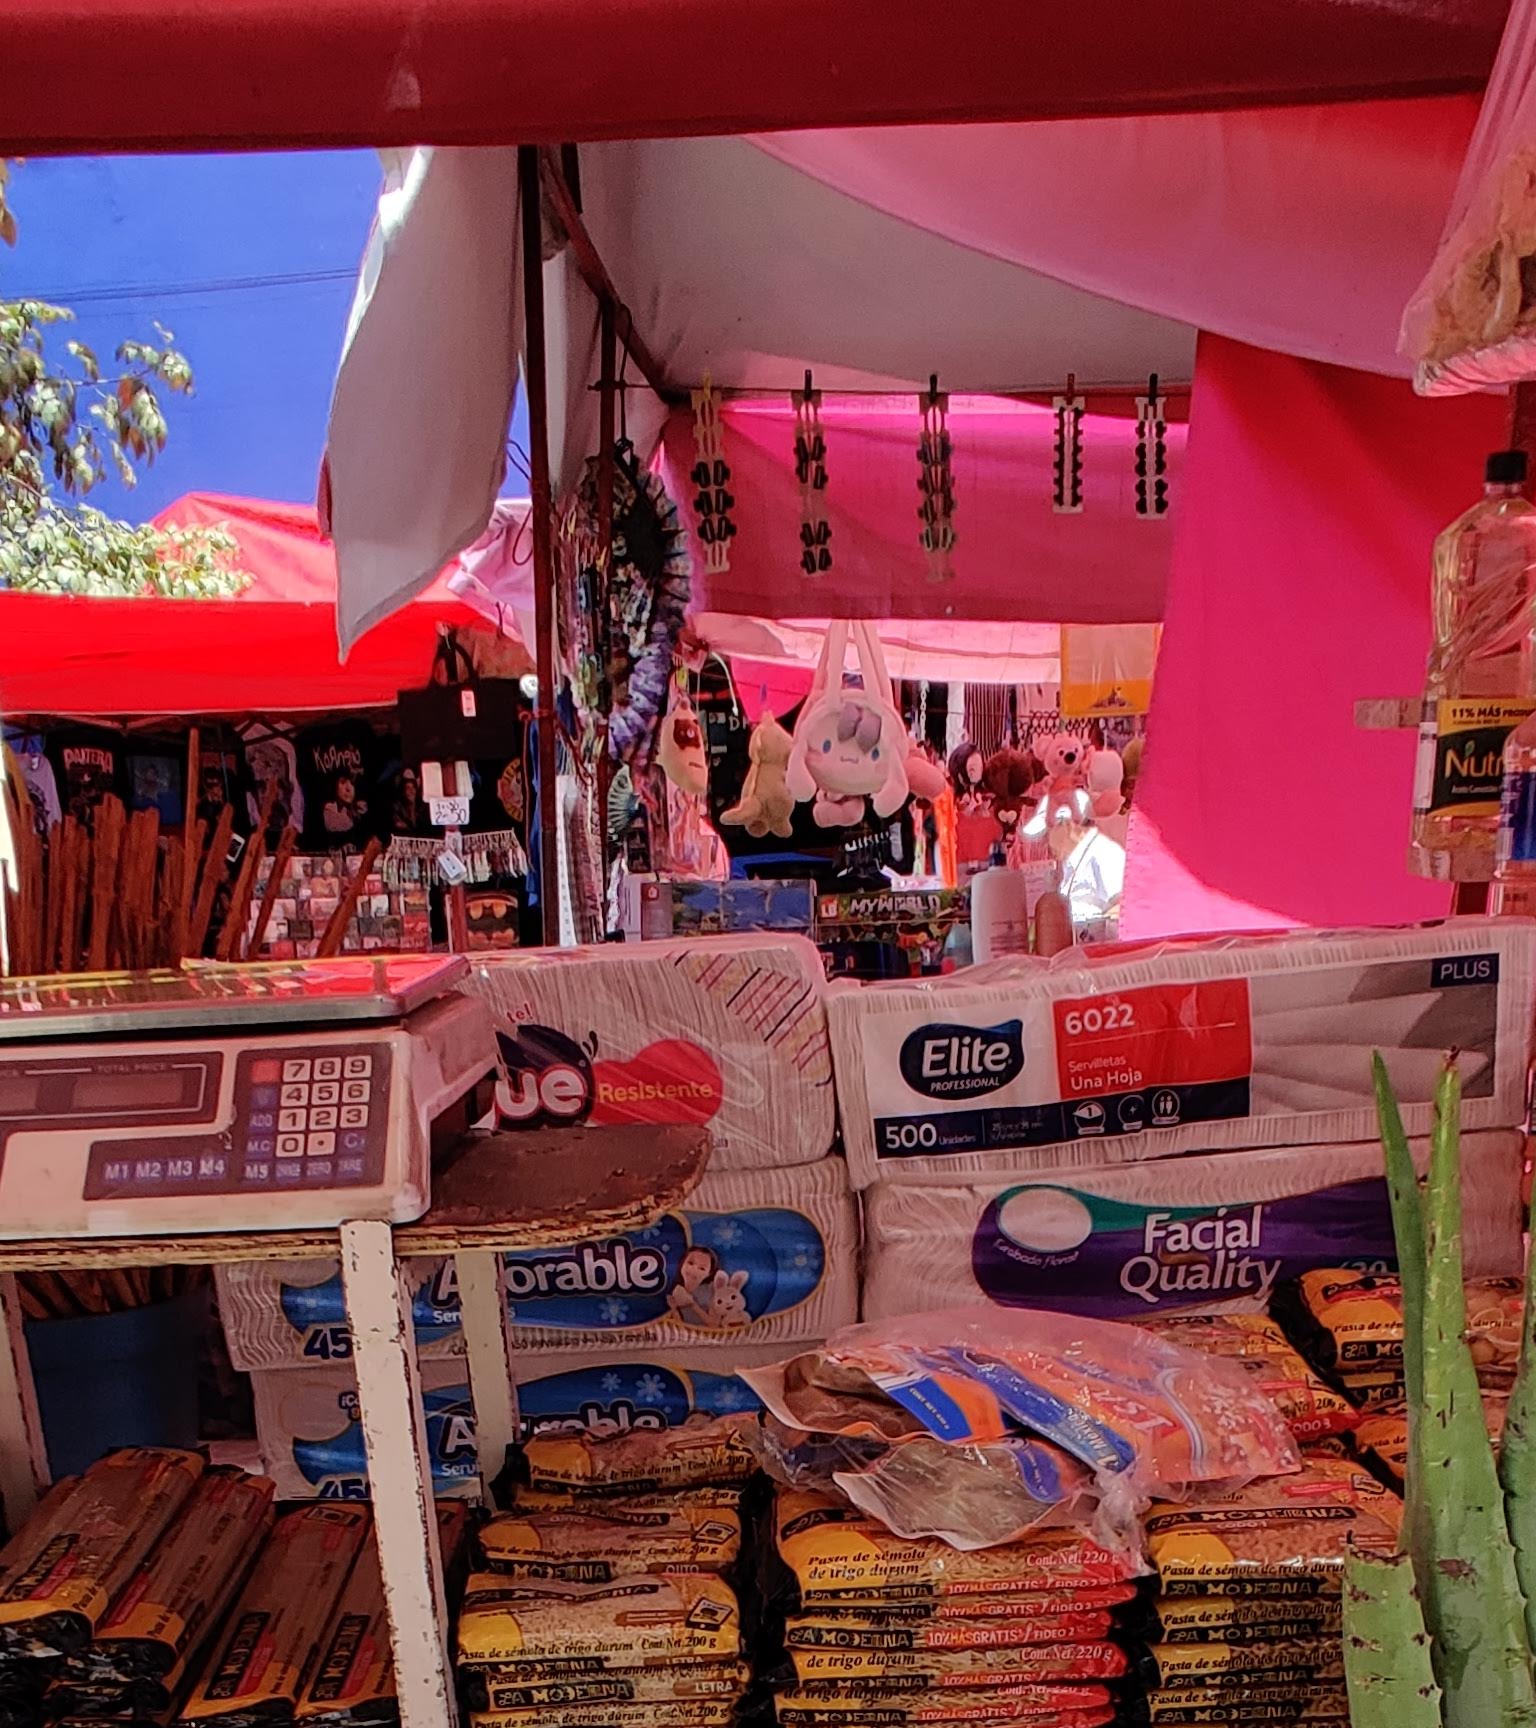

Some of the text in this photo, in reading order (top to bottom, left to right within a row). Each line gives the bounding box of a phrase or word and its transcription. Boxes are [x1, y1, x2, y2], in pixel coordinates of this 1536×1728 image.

[1451, 707, 1475, 718] 11%
[1477, 705, 1501, 718] MÁS
[850, 894, 941, 915] MYWORLD
[1440, 958, 1491, 981] PLUS
[1065, 1006, 1135, 1035] 6022
[922, 1036, 1010, 1078] Elite
[1068, 1055, 1126, 1073] Servilletas
[97, 1064, 131, 1074] TOTAL
[288, 1062, 305, 1078] 7
[319, 1060, 336, 1076] 8
[349, 1058, 366, 1074] 9
[930, 1077, 1000, 1092] PROFESSIONAL
[1070, 1069, 1143, 1091] Una Hoja
[286, 1086, 303, 1102] 4
[317, 1084, 334, 1100] 5
[347, 1082, 364, 1098] 6
[599, 1081, 713, 1103] Resistente
[286, 1111, 298, 1126] 1
[346, 1108, 362, 1123] 3
[885, 1123, 937, 1149] 500
[282, 1137, 299, 1153] 0
[105, 1163, 129, 1180] M1
[135, 1161, 161, 1179] M2
[167, 1160, 193, 1177] M3
[199, 1159, 225, 1176] M4
[1144, 1206, 1263, 1253] Facial
[1120, 1247, 1282, 1303] Quality
[809, 1547, 927, 1567] Pasta de sémola
[809, 1567, 826, 1580] de
[829, 1565, 865, 1580] trigo
[868, 1562, 921, 1577] durum
[1082, 1550, 1109, 1564] 220
[1162, 1563, 1196, 1577] Pasta
[1198, 1563, 1213, 1576] de
[807, 1655, 824, 1669] de
[828, 1654, 863, 1670] trigo
[866, 1651, 915, 1668] durum
[1076, 1645, 1102, 1660] 220
[695, 1680, 734, 1694] LETRA
